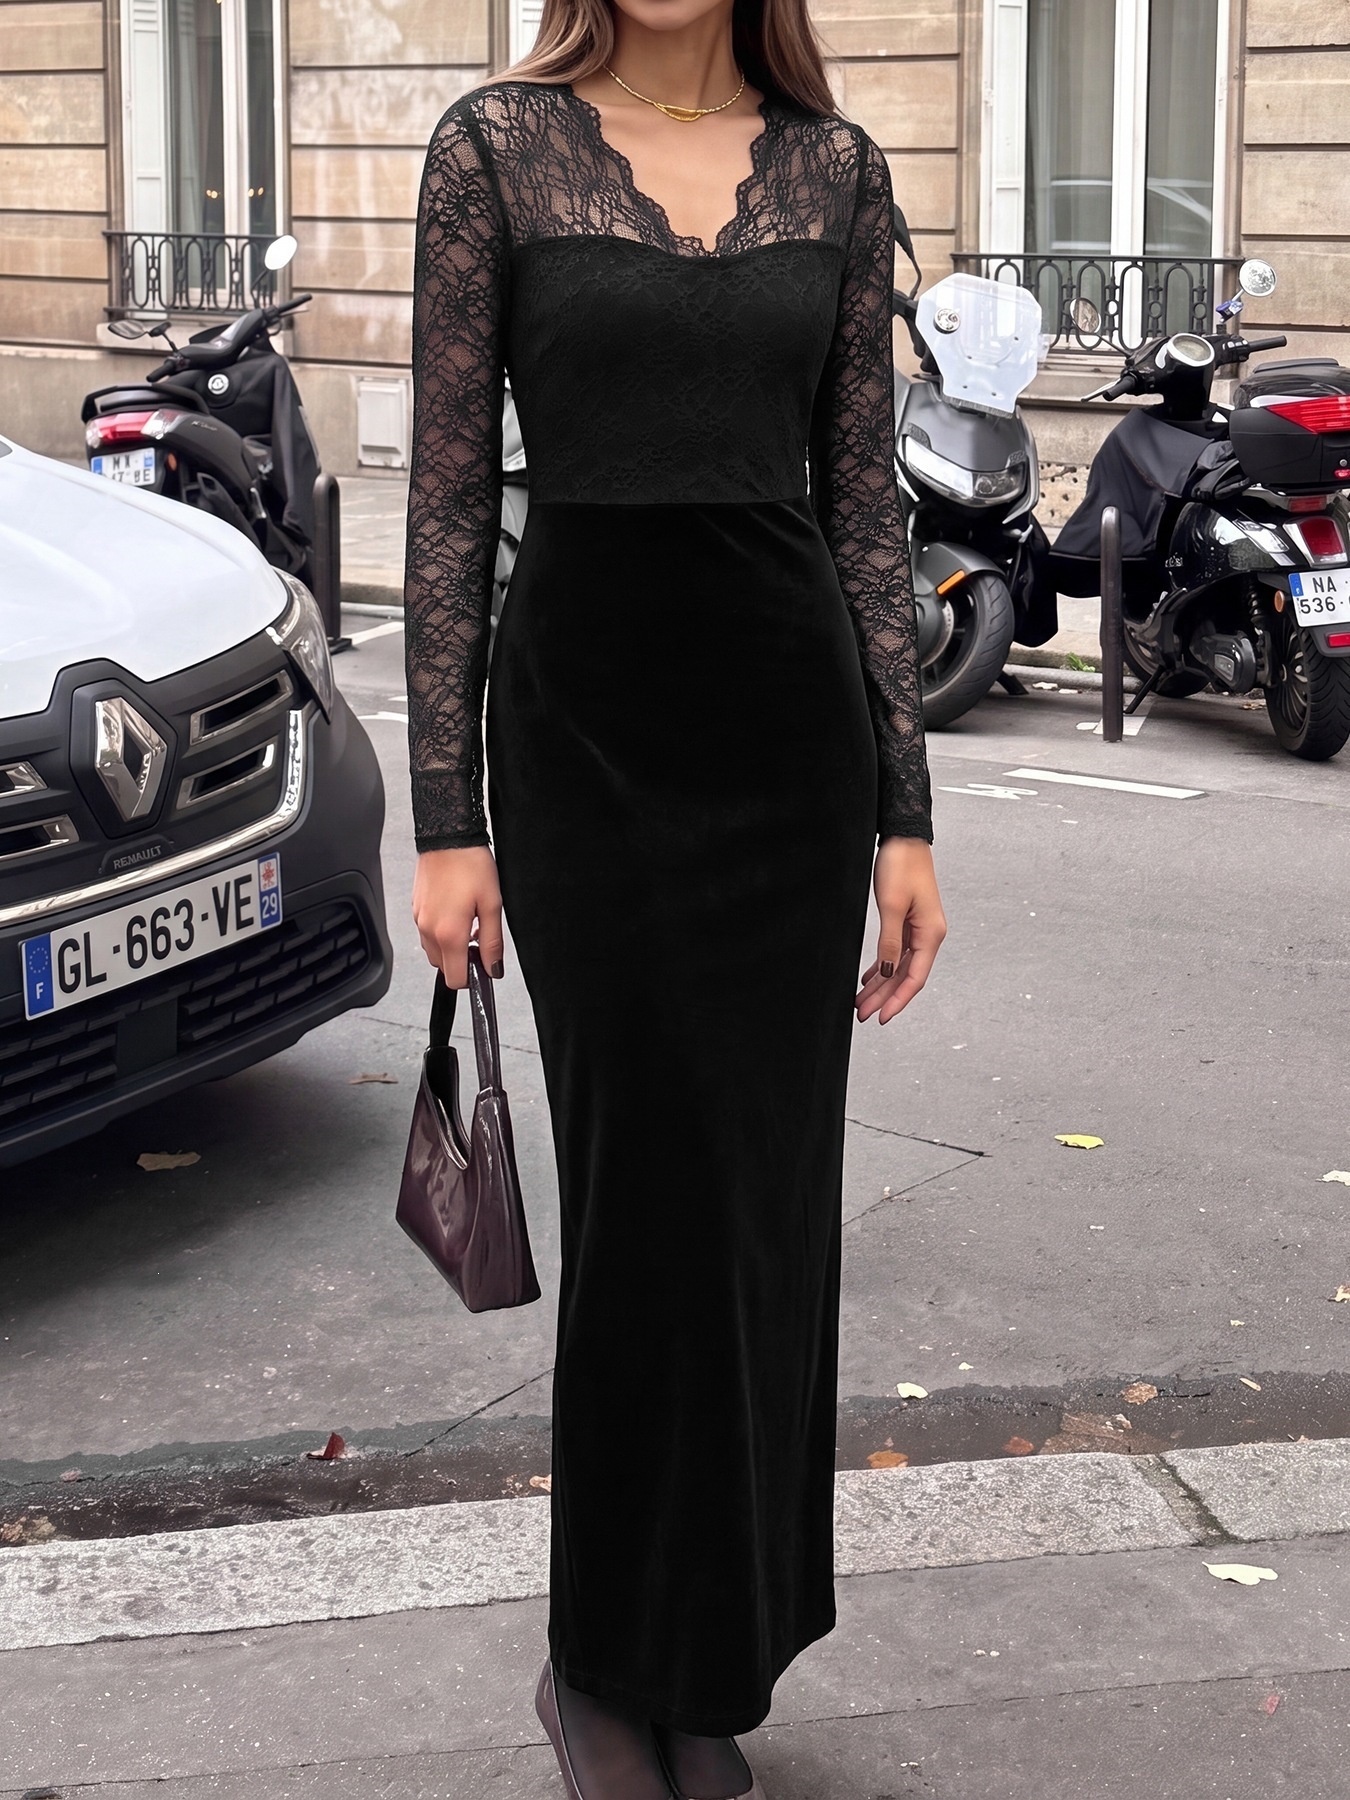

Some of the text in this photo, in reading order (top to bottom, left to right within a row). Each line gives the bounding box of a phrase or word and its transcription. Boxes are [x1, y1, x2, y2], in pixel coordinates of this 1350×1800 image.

[262, 892, 278, 919] 29
[57, 873, 254, 994] GL-663-VE
[36, 982, 44, 999] F
